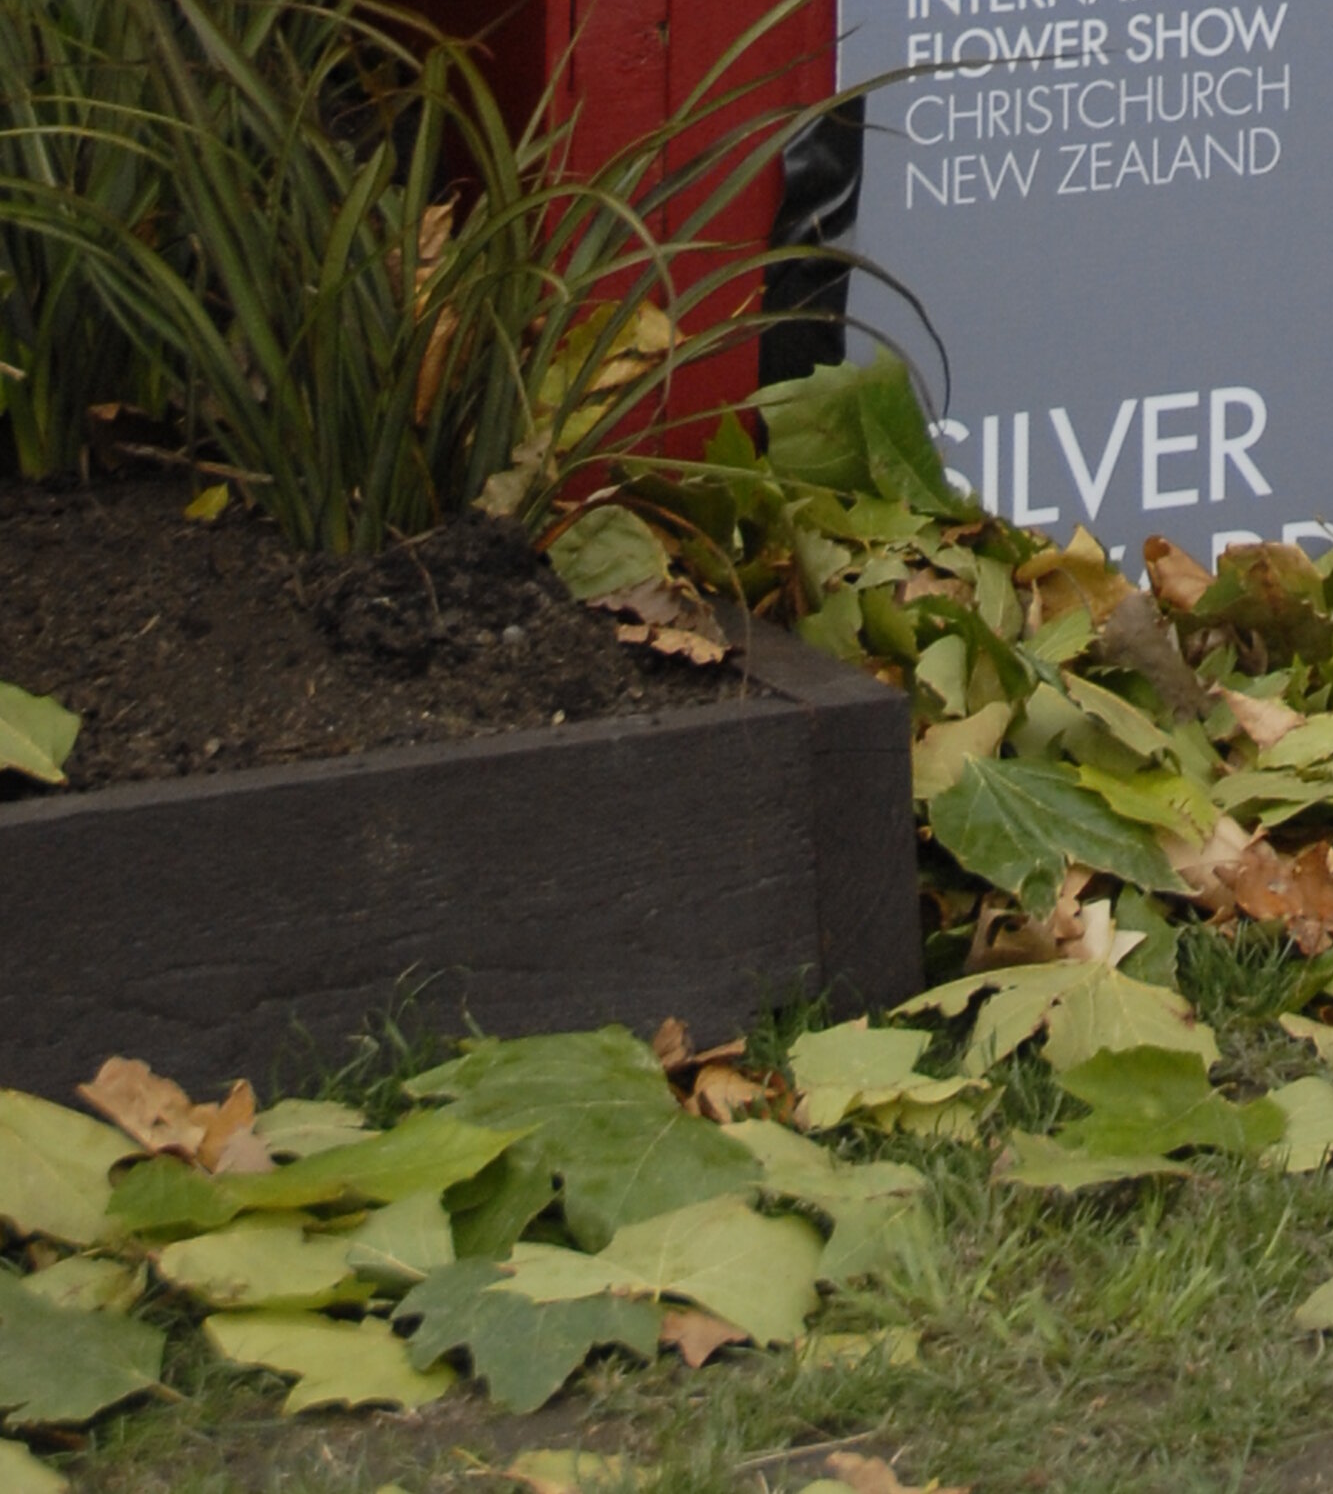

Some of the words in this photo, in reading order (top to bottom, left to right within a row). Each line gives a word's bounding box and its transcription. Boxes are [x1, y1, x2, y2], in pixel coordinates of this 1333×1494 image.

[906, 17, 1110, 83] FLOWER
[1125, 2, 1290, 64] SHOW
[905, 64, 1292, 147] CHRISTCHURCH
[904, 150, 1040, 210] NEW
[1056, 126, 1282, 196] ZEALAND
